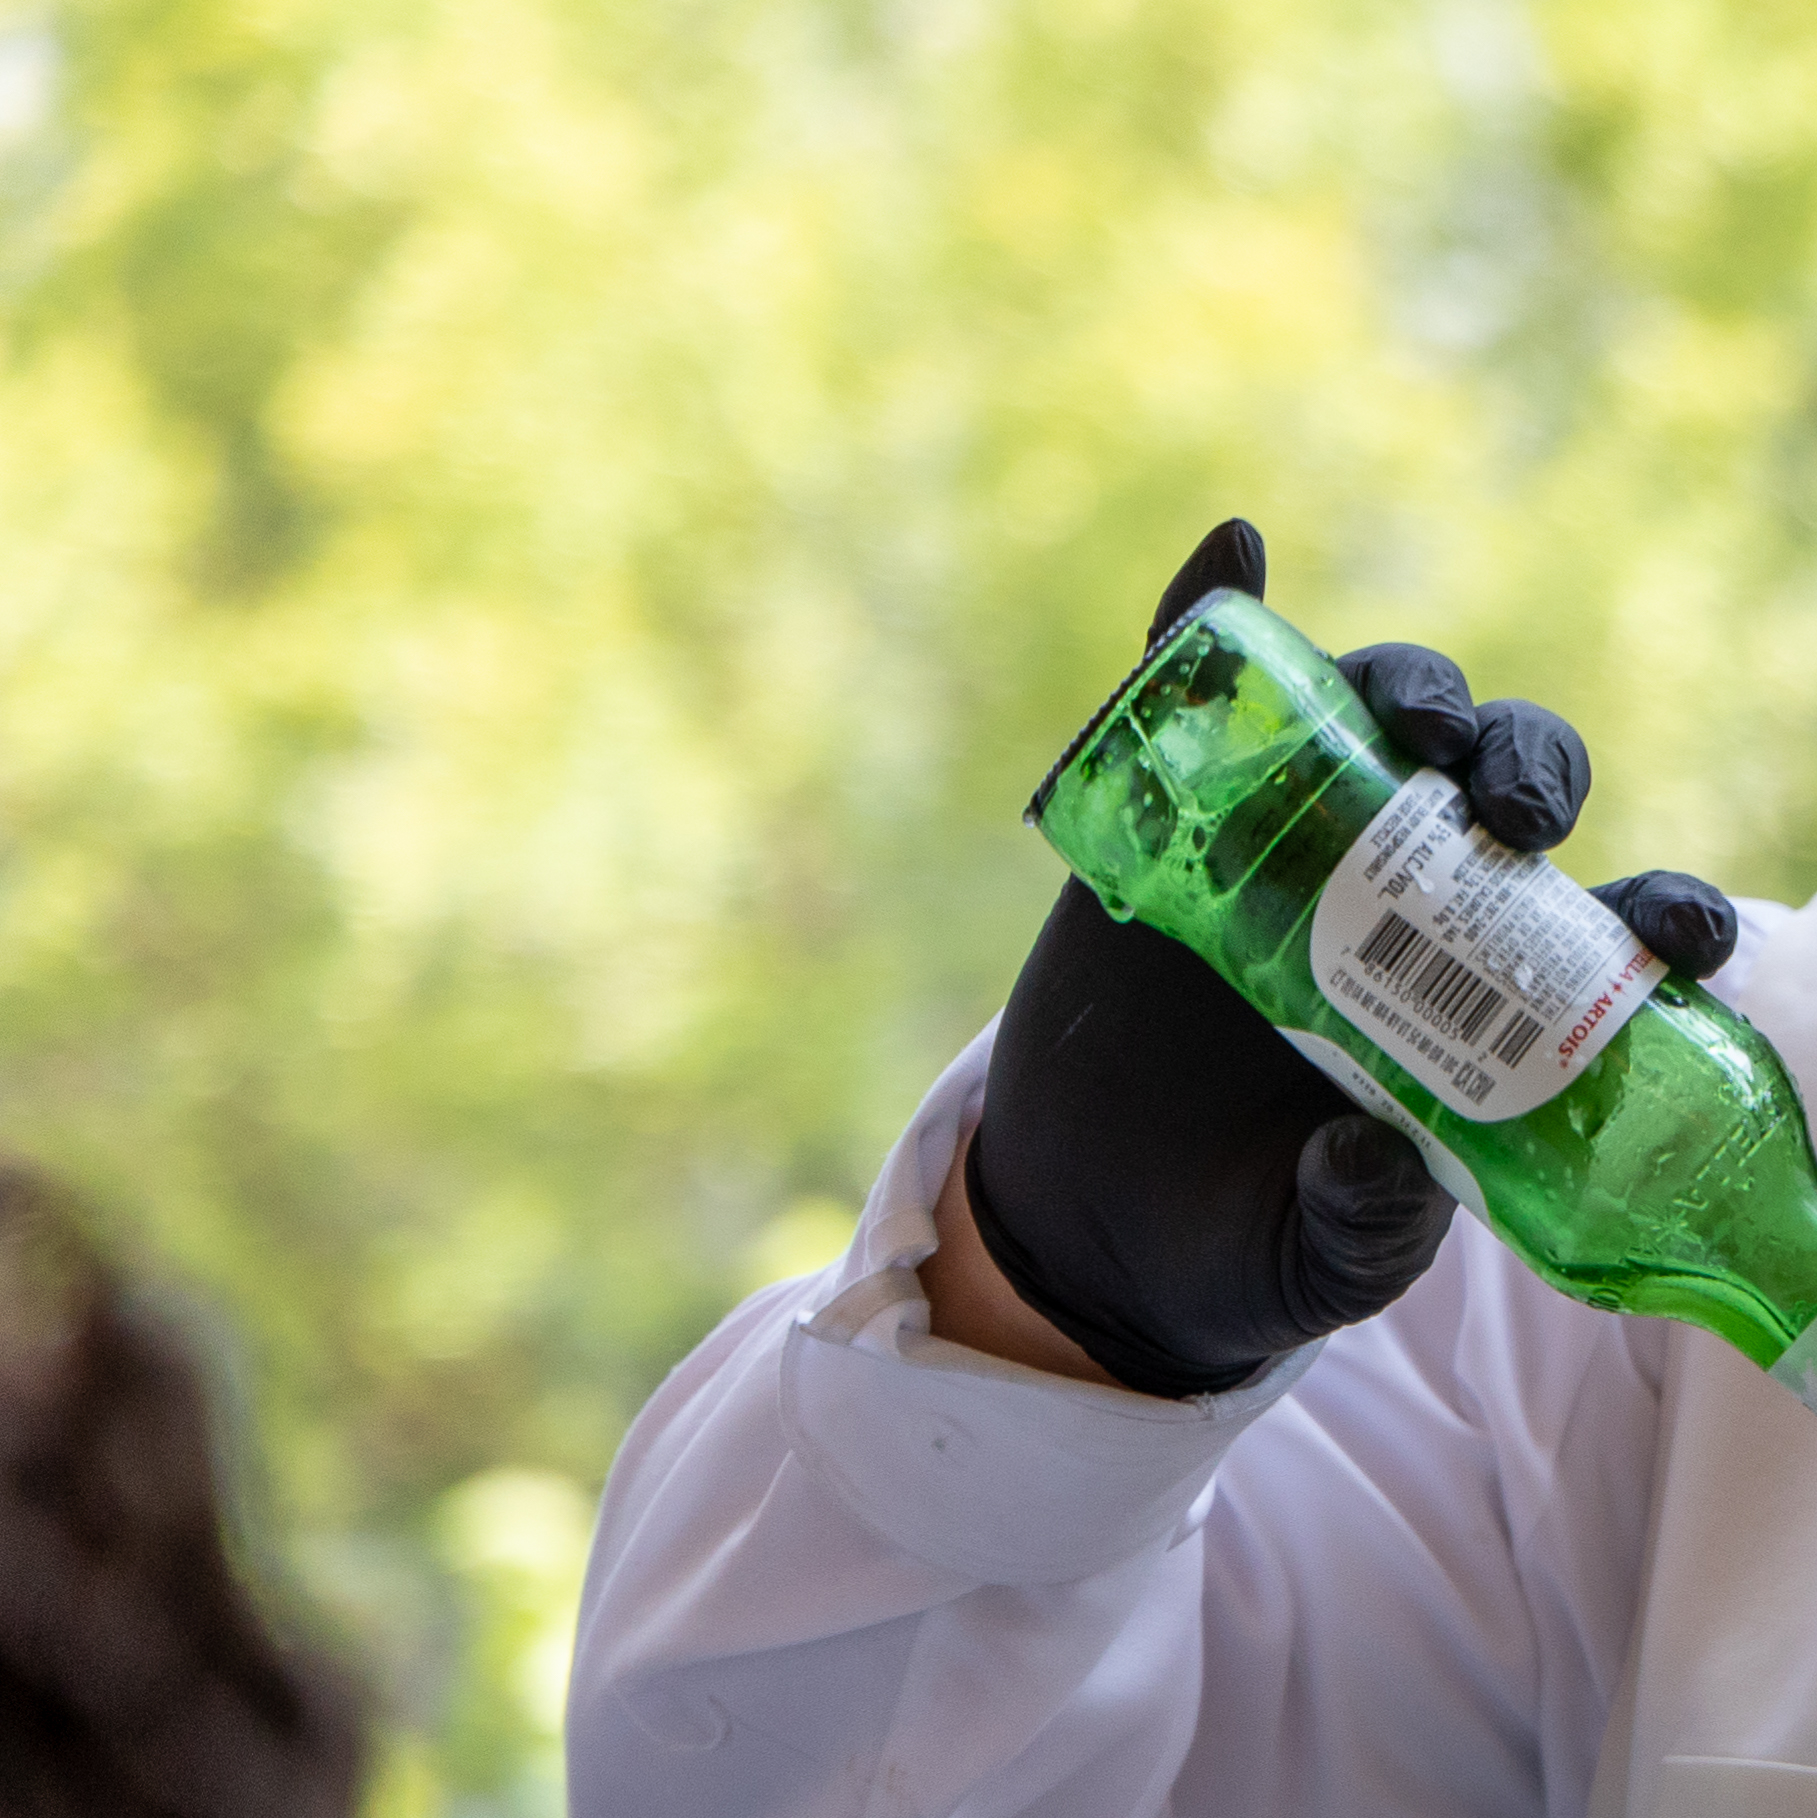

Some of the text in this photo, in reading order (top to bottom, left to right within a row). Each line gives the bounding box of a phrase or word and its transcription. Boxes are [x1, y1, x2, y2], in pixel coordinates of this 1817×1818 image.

[1425, 821, 1452, 849] 5%
[1361, 961, 1414, 1005] 86150
[1410, 998, 1463, 1042] 00005
